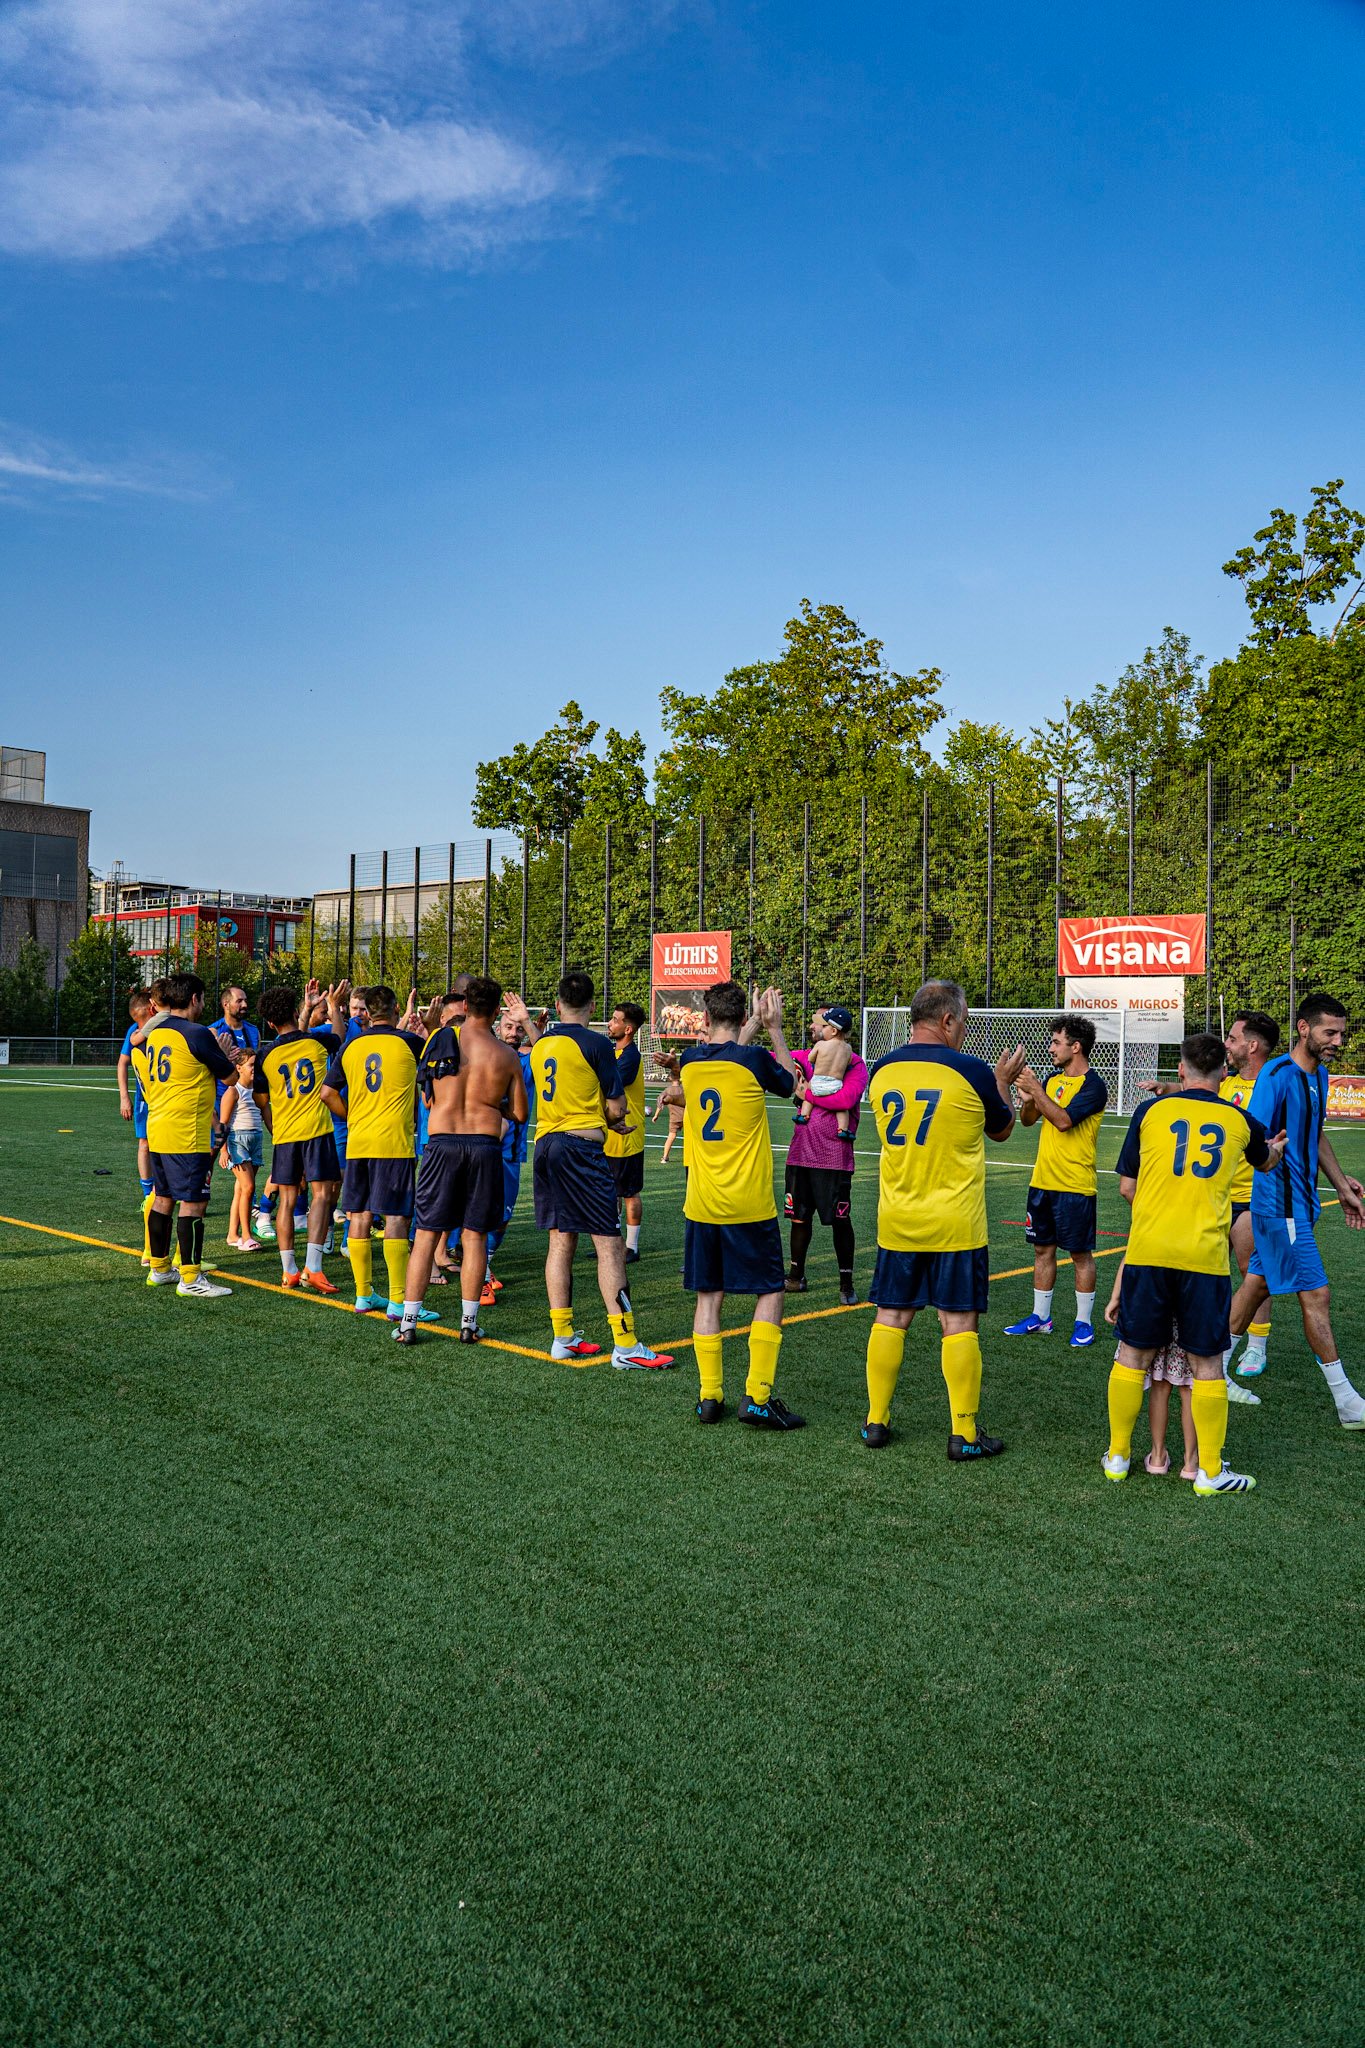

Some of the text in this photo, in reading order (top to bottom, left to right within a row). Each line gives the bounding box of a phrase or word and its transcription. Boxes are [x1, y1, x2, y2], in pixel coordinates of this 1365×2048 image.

[664, 943, 719, 965] LÜTHI'S
[664, 967, 718, 976] FLEISCHWAREN
[1070, 999, 1118, 1009] MIGROS
[1129, 999, 1179, 1009] MIGROS
[147, 1046, 172, 1083] 26
[278, 1058, 316, 1098] 19
[365, 1053, 383, 1093] 8
[542, 1057, 557, 1102] 3
[699, 1087, 725, 1142] 2
[881, 1088, 943, 1146] 27
[1169, 1117, 1226, 1179] 13
[747, 1404, 769, 1418] FILA
[962, 1445, 982, 1454] FILA
